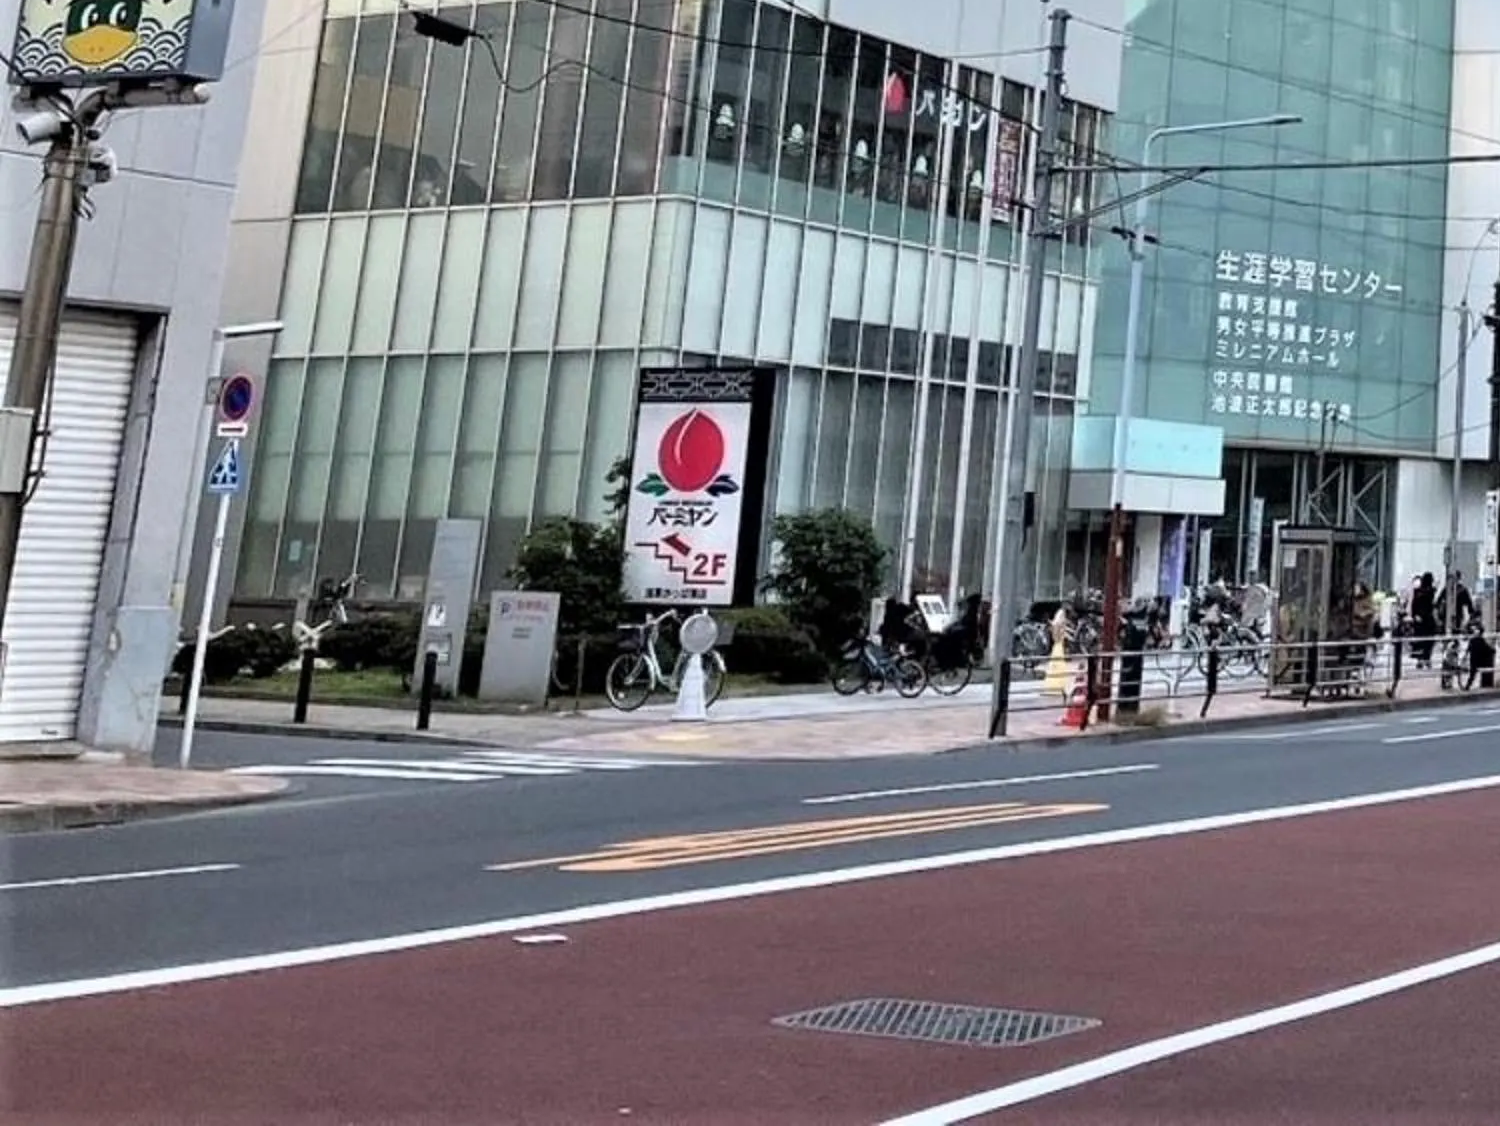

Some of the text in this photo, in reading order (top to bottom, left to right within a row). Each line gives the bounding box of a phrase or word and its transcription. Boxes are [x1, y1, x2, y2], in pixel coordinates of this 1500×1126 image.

[1215, 249, 1403, 299] 生涯学習センター
[647, 506, 719, 528] バーミヤン
[692, 553, 727, 577] 2F
